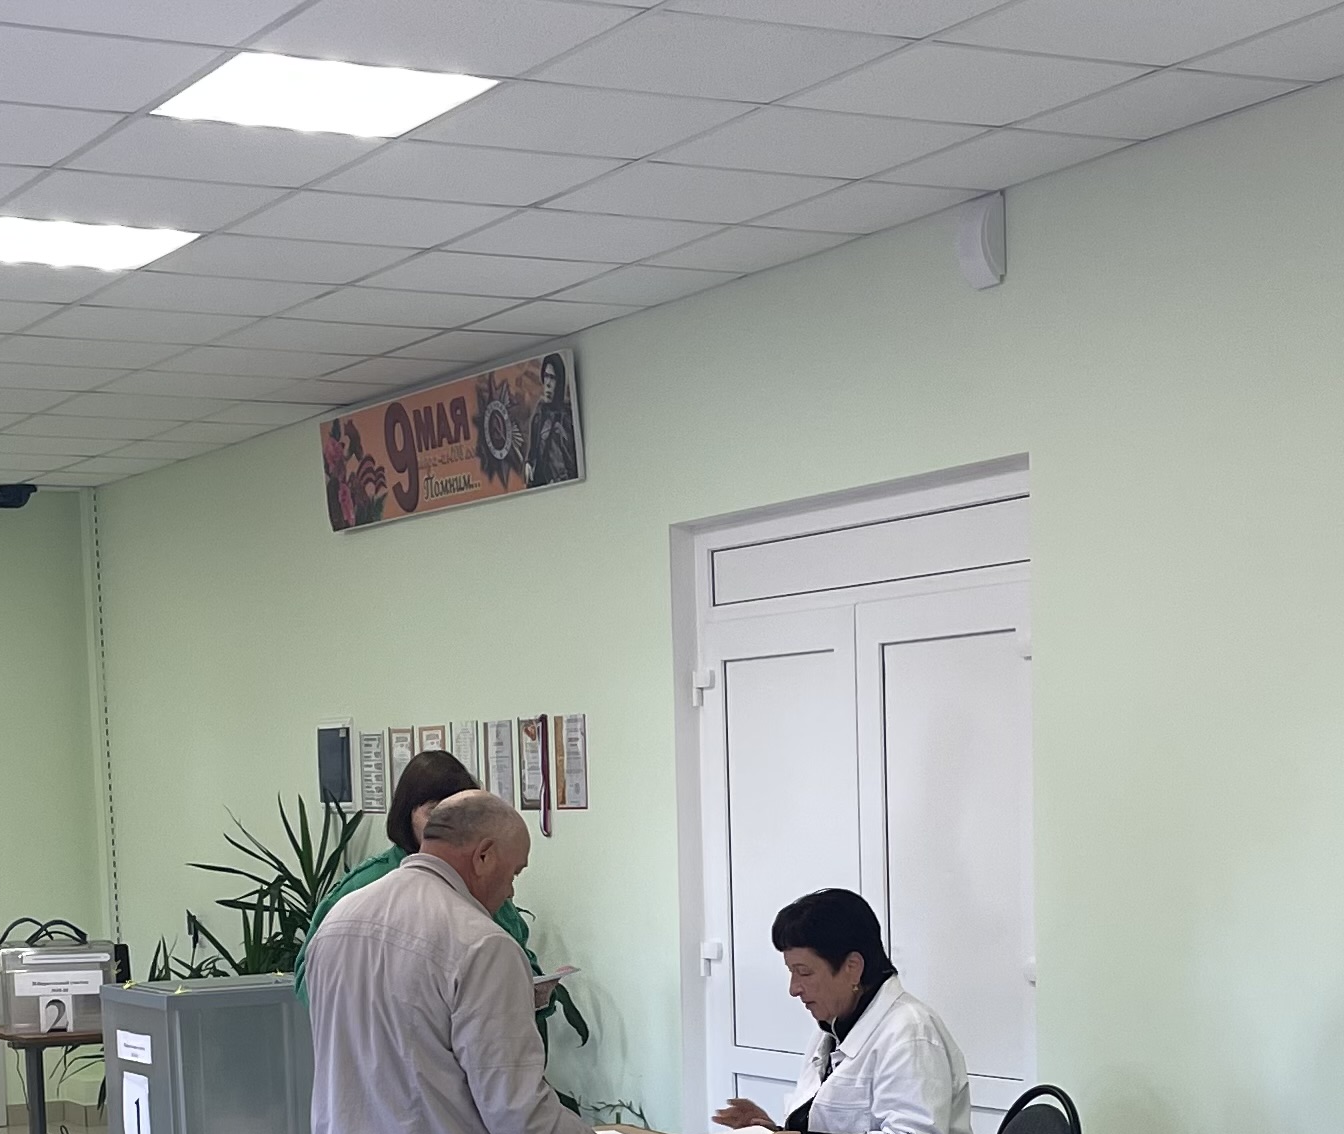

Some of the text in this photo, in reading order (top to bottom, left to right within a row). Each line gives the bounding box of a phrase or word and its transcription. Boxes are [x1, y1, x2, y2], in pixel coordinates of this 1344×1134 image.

[384, 402, 419, 513] 9
[413, 396, 471, 453] МАЯ
[44, 998, 69, 1033] 2
